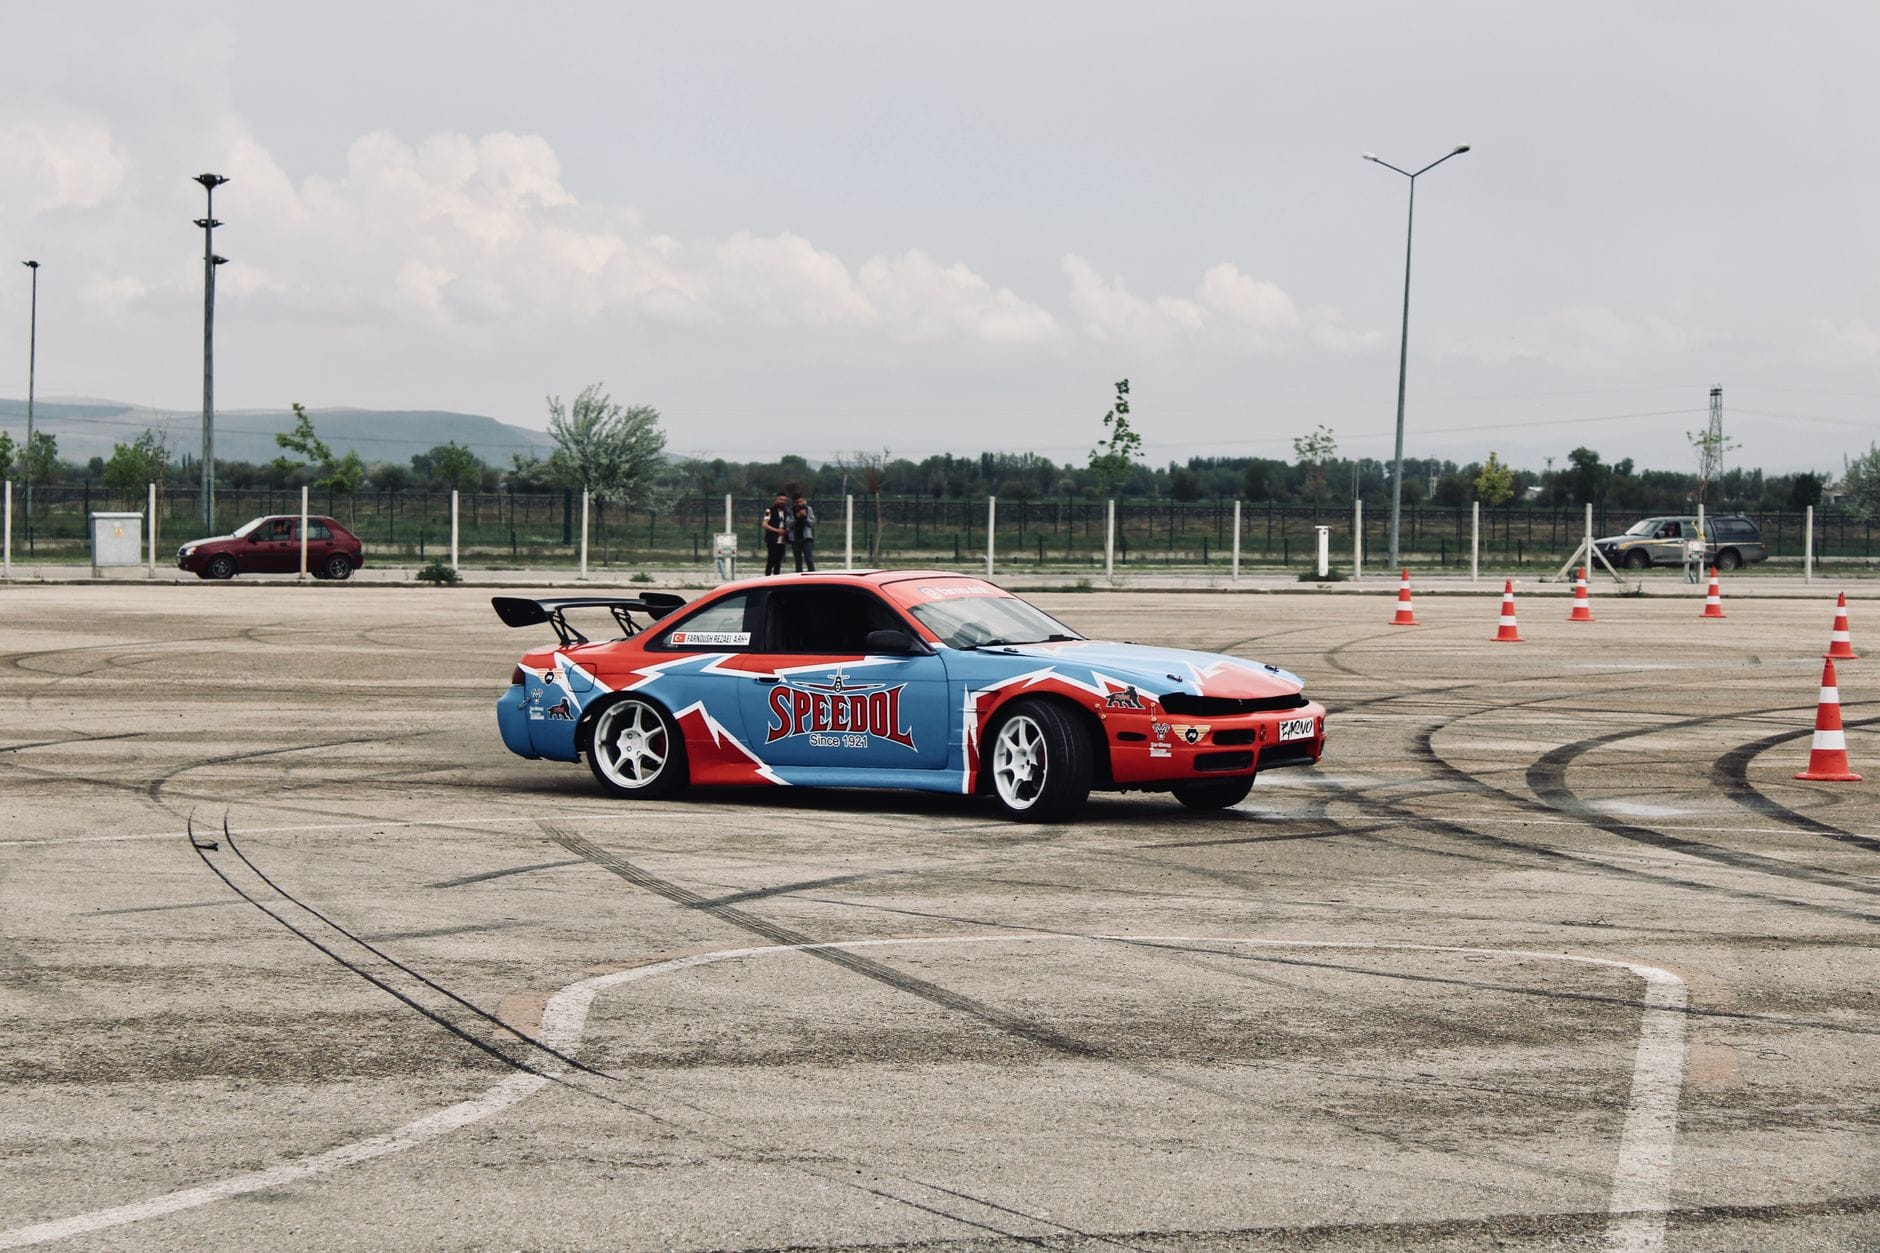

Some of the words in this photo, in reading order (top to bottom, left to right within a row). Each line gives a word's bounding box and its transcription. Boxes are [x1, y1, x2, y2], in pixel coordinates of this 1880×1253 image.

[765, 682, 919, 753] SPEEDOL
[809, 734, 840, 747] Since
[843, 734, 868, 748] 1921
